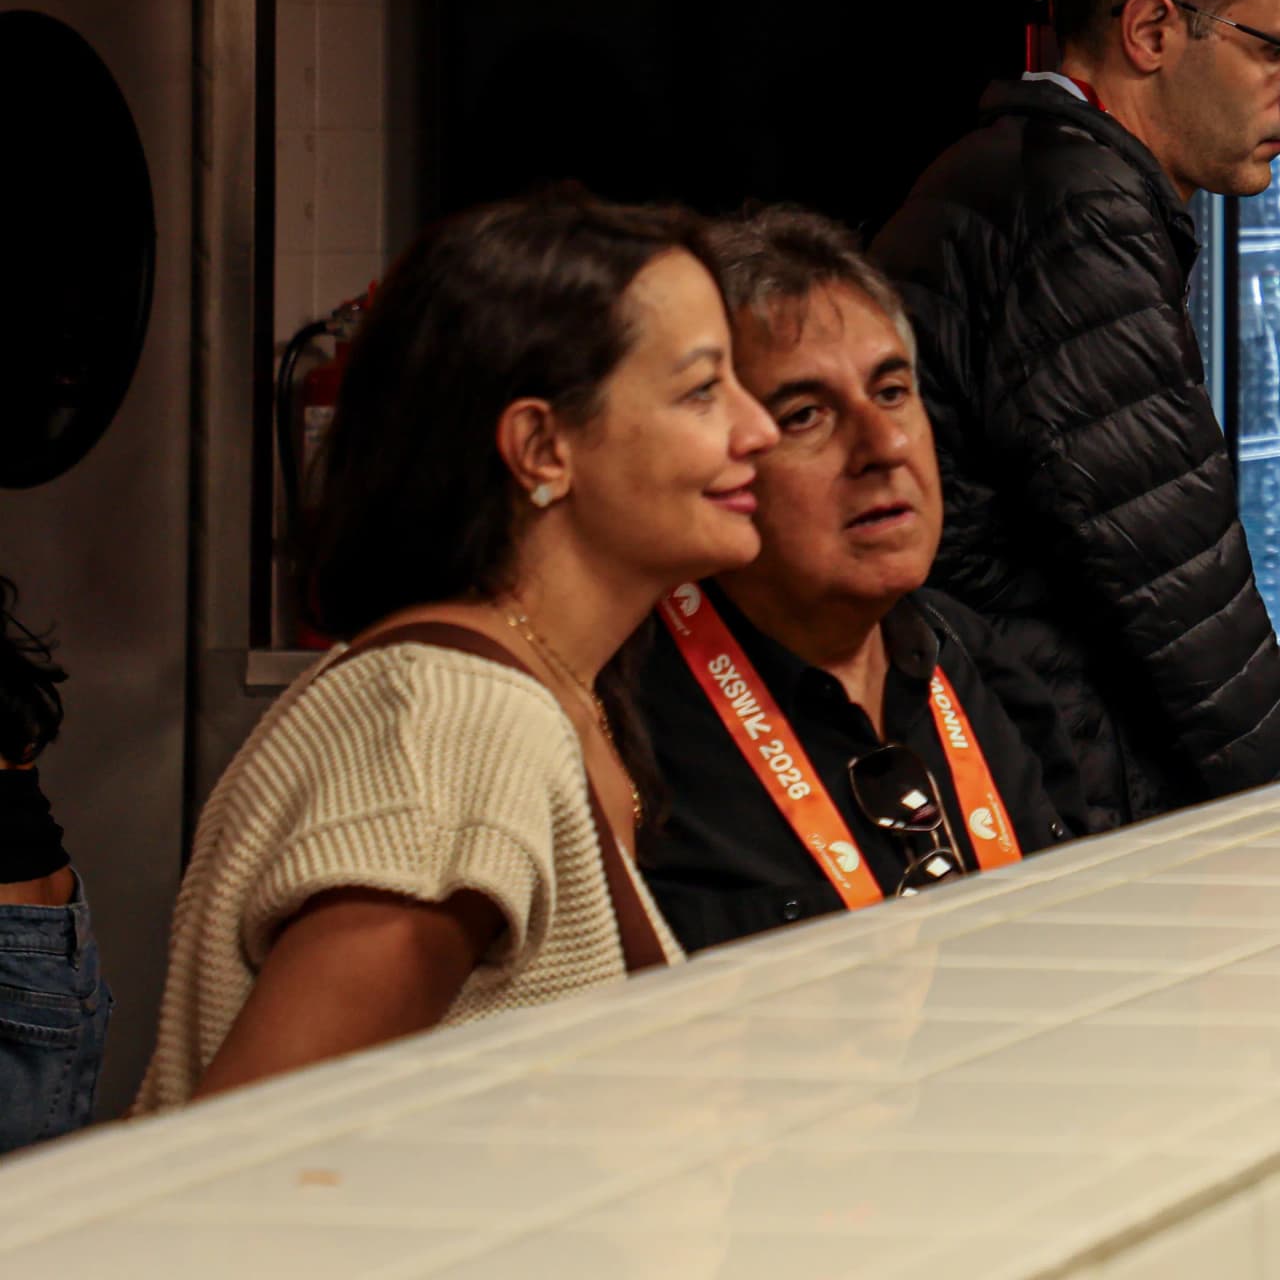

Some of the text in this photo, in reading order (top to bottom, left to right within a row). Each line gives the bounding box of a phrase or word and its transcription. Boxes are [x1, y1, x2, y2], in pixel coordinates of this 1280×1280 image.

[707, 653, 812, 801] SXSW 2026
[930, 675, 969, 749] INNOV
